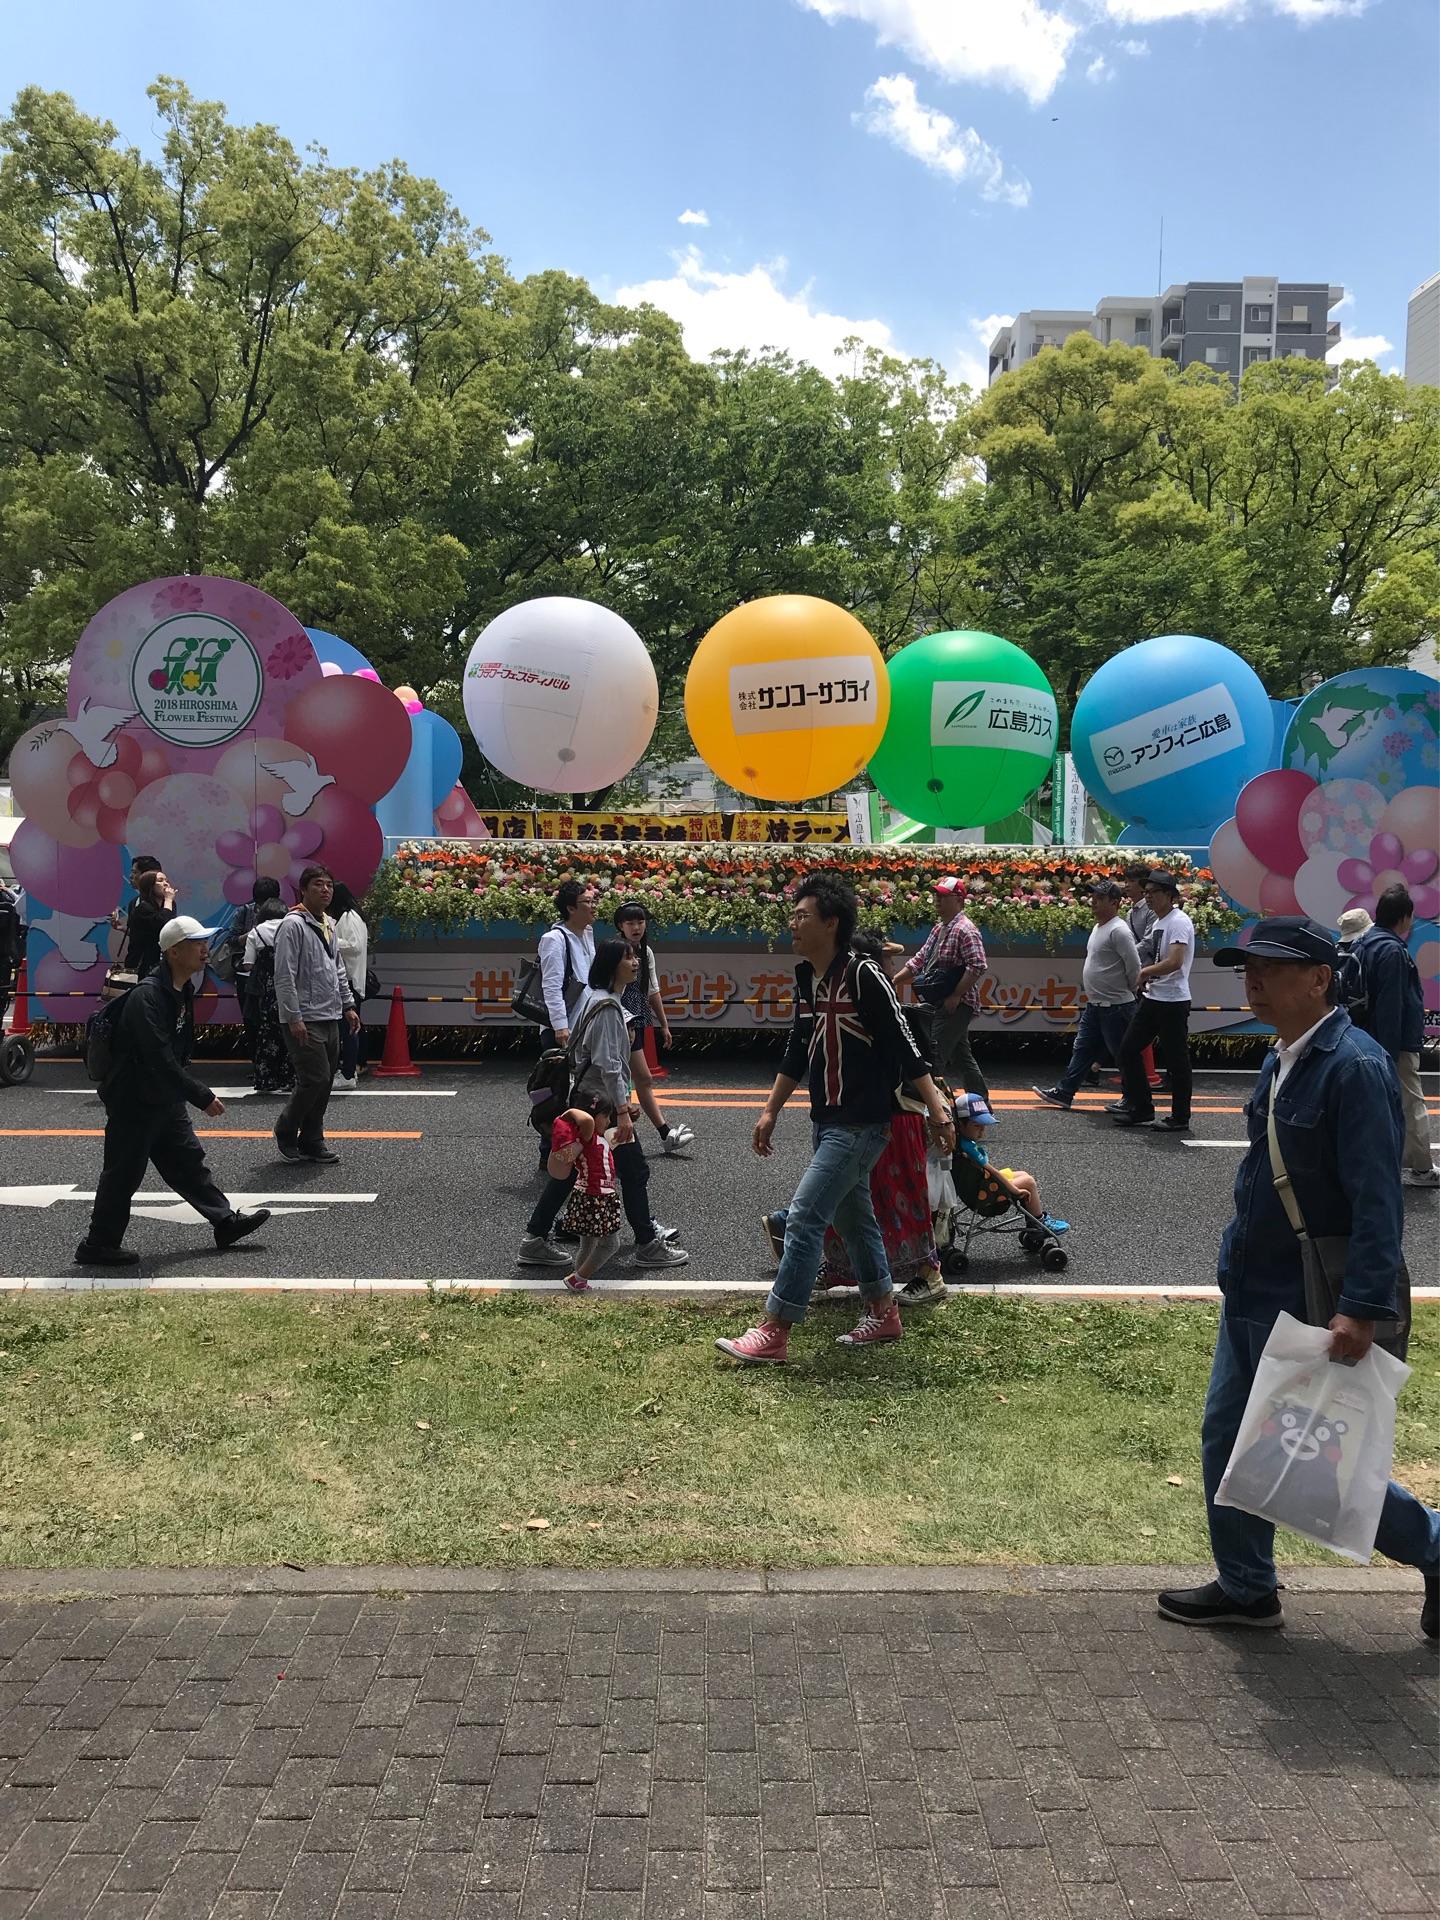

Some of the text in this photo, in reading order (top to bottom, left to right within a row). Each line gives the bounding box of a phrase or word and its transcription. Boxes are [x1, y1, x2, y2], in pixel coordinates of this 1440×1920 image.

[477, 668, 570, 690] フラワーフェスティバル
[154, 699, 238, 711] 2018 HIROSHIMA
[738, 692, 756, 701] 株式
[758, 679, 870, 710] サンコーサプライ
[738, 701, 757, 711] 会社
[988, 708, 1052, 740] 広島ガス
[1131, 713, 1232, 765] アンフィニ広島
